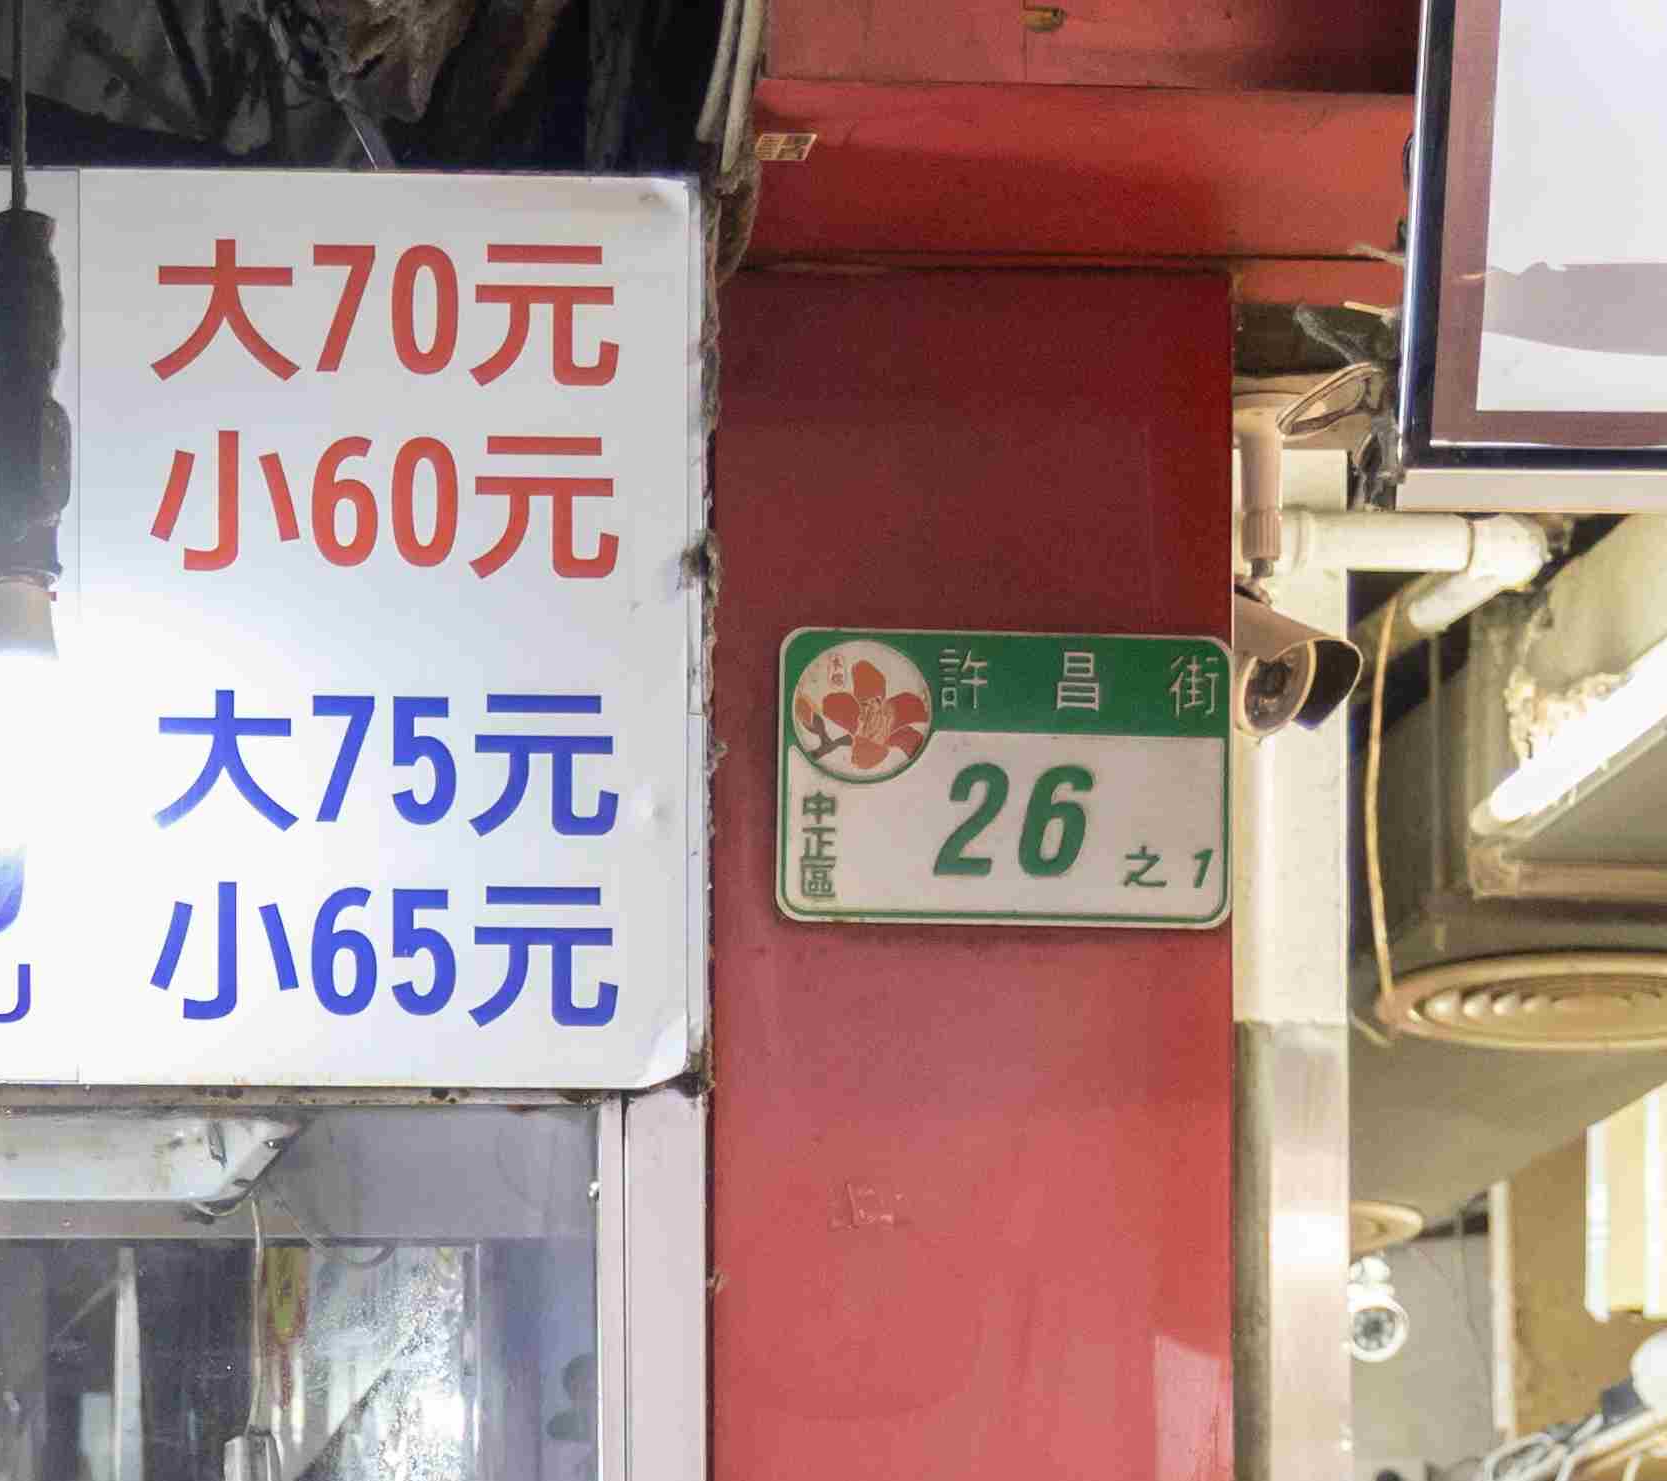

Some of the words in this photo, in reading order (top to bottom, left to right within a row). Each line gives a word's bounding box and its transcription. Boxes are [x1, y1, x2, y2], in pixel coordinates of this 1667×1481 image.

[151, 238, 619, 388] 大70元
[151, 432, 619, 580] 小60元
[939, 648, 1219, 720] 許昌街
[151, 689, 619, 838] 大75元
[931, 761, 1096, 879] 26
[799, 789, 839, 900] 中正區
[150, 882, 619, 1028] 小65元
